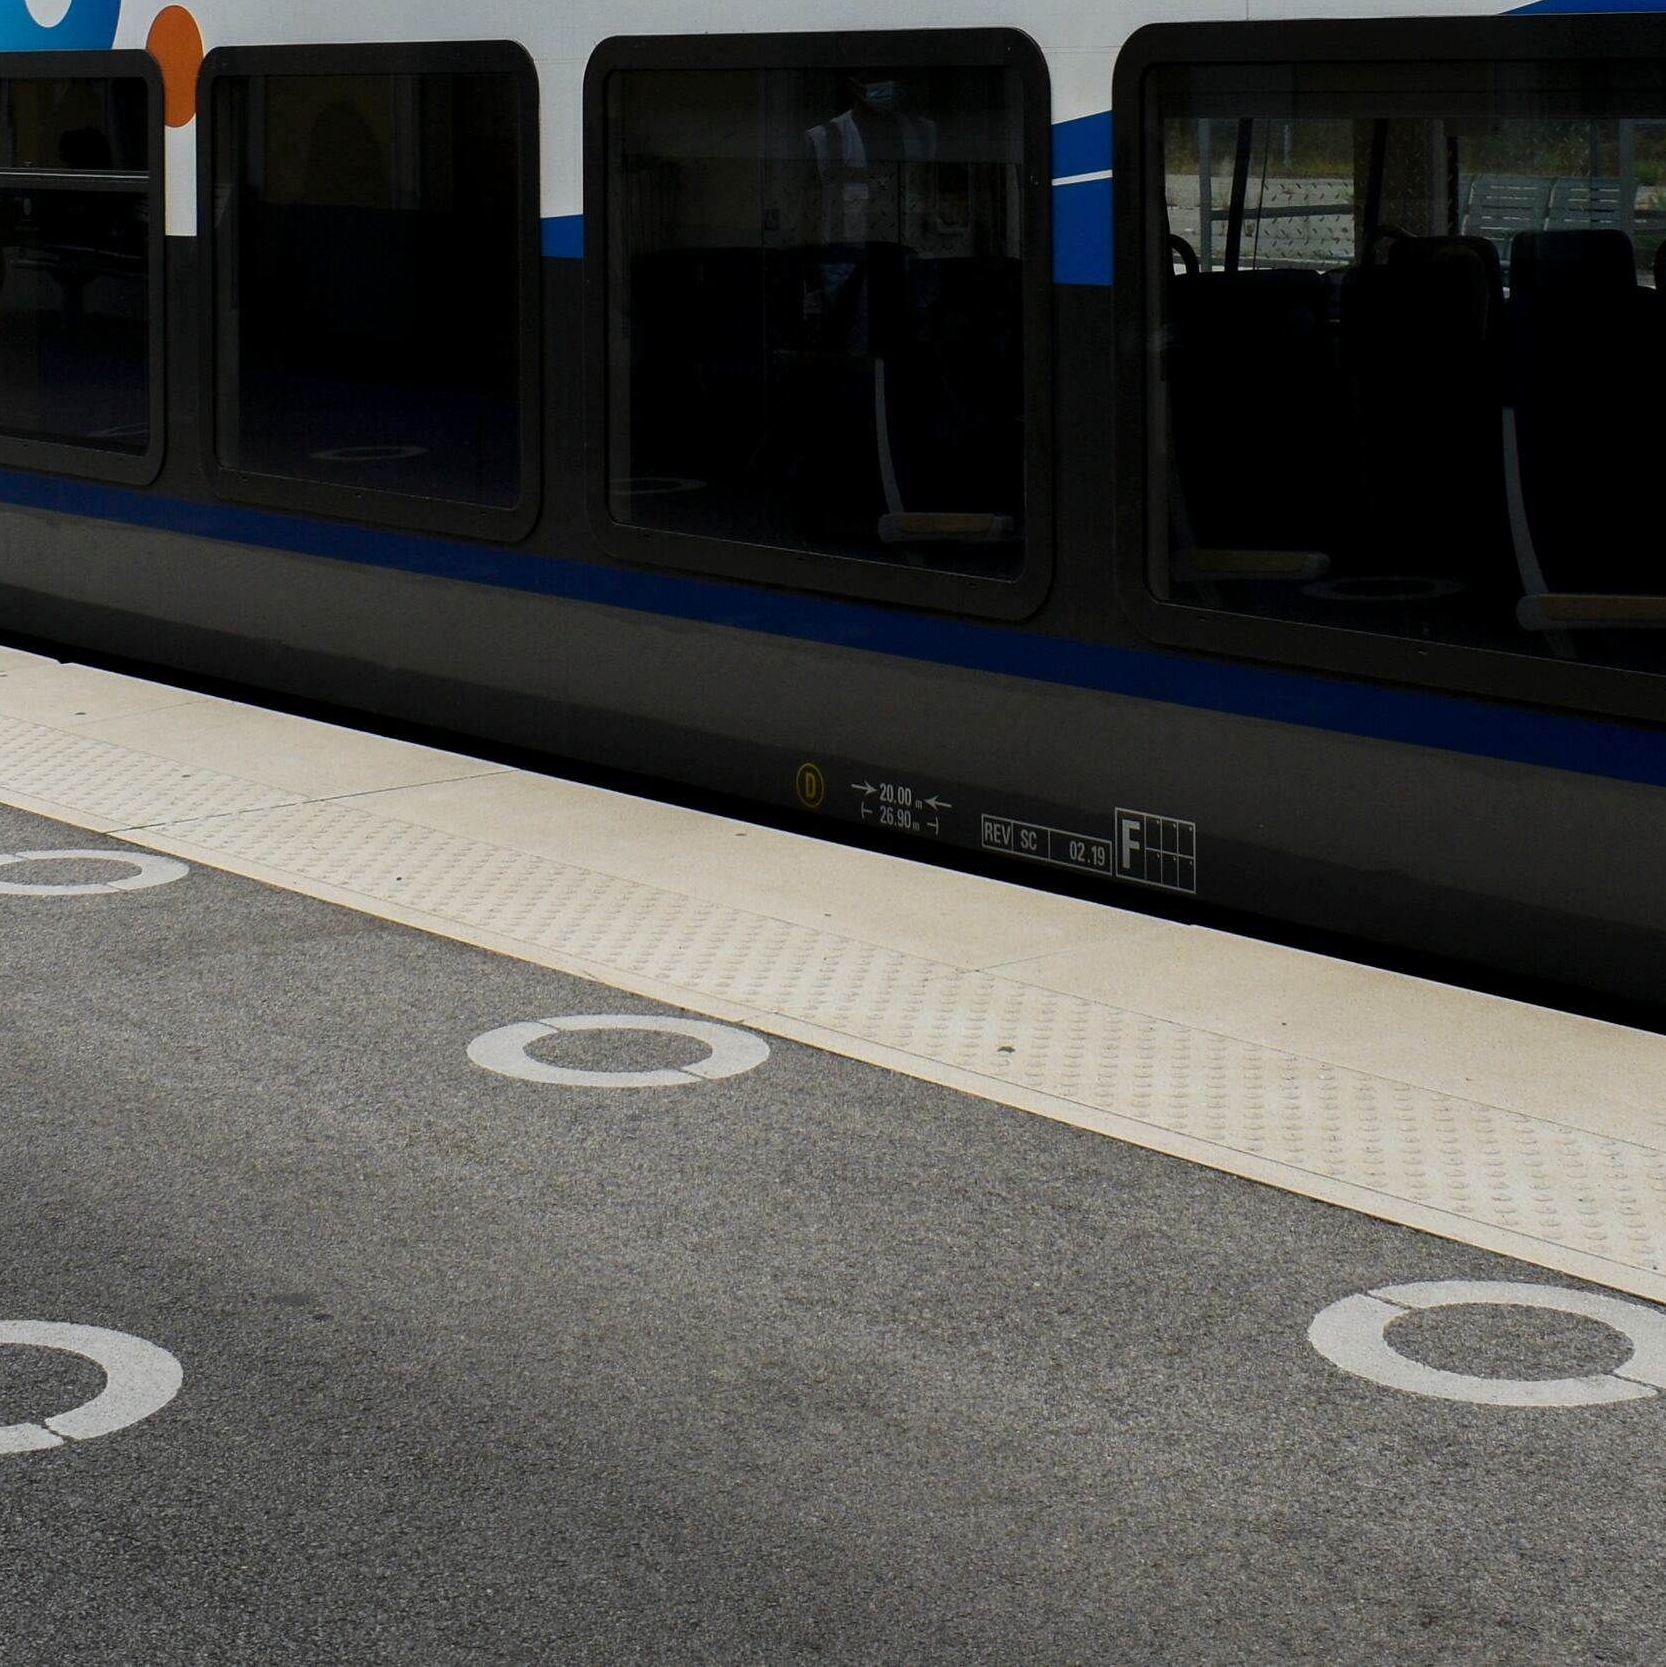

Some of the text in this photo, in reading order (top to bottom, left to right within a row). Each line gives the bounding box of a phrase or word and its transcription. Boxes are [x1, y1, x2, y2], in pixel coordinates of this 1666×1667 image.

[805, 772, 817, 799] D
[879, 783, 912, 807] 20.00
[879, 805, 912, 829] 26.90
[984, 821, 1106, 867] REV SC 02.19
[1121, 818, 1141, 870] F
